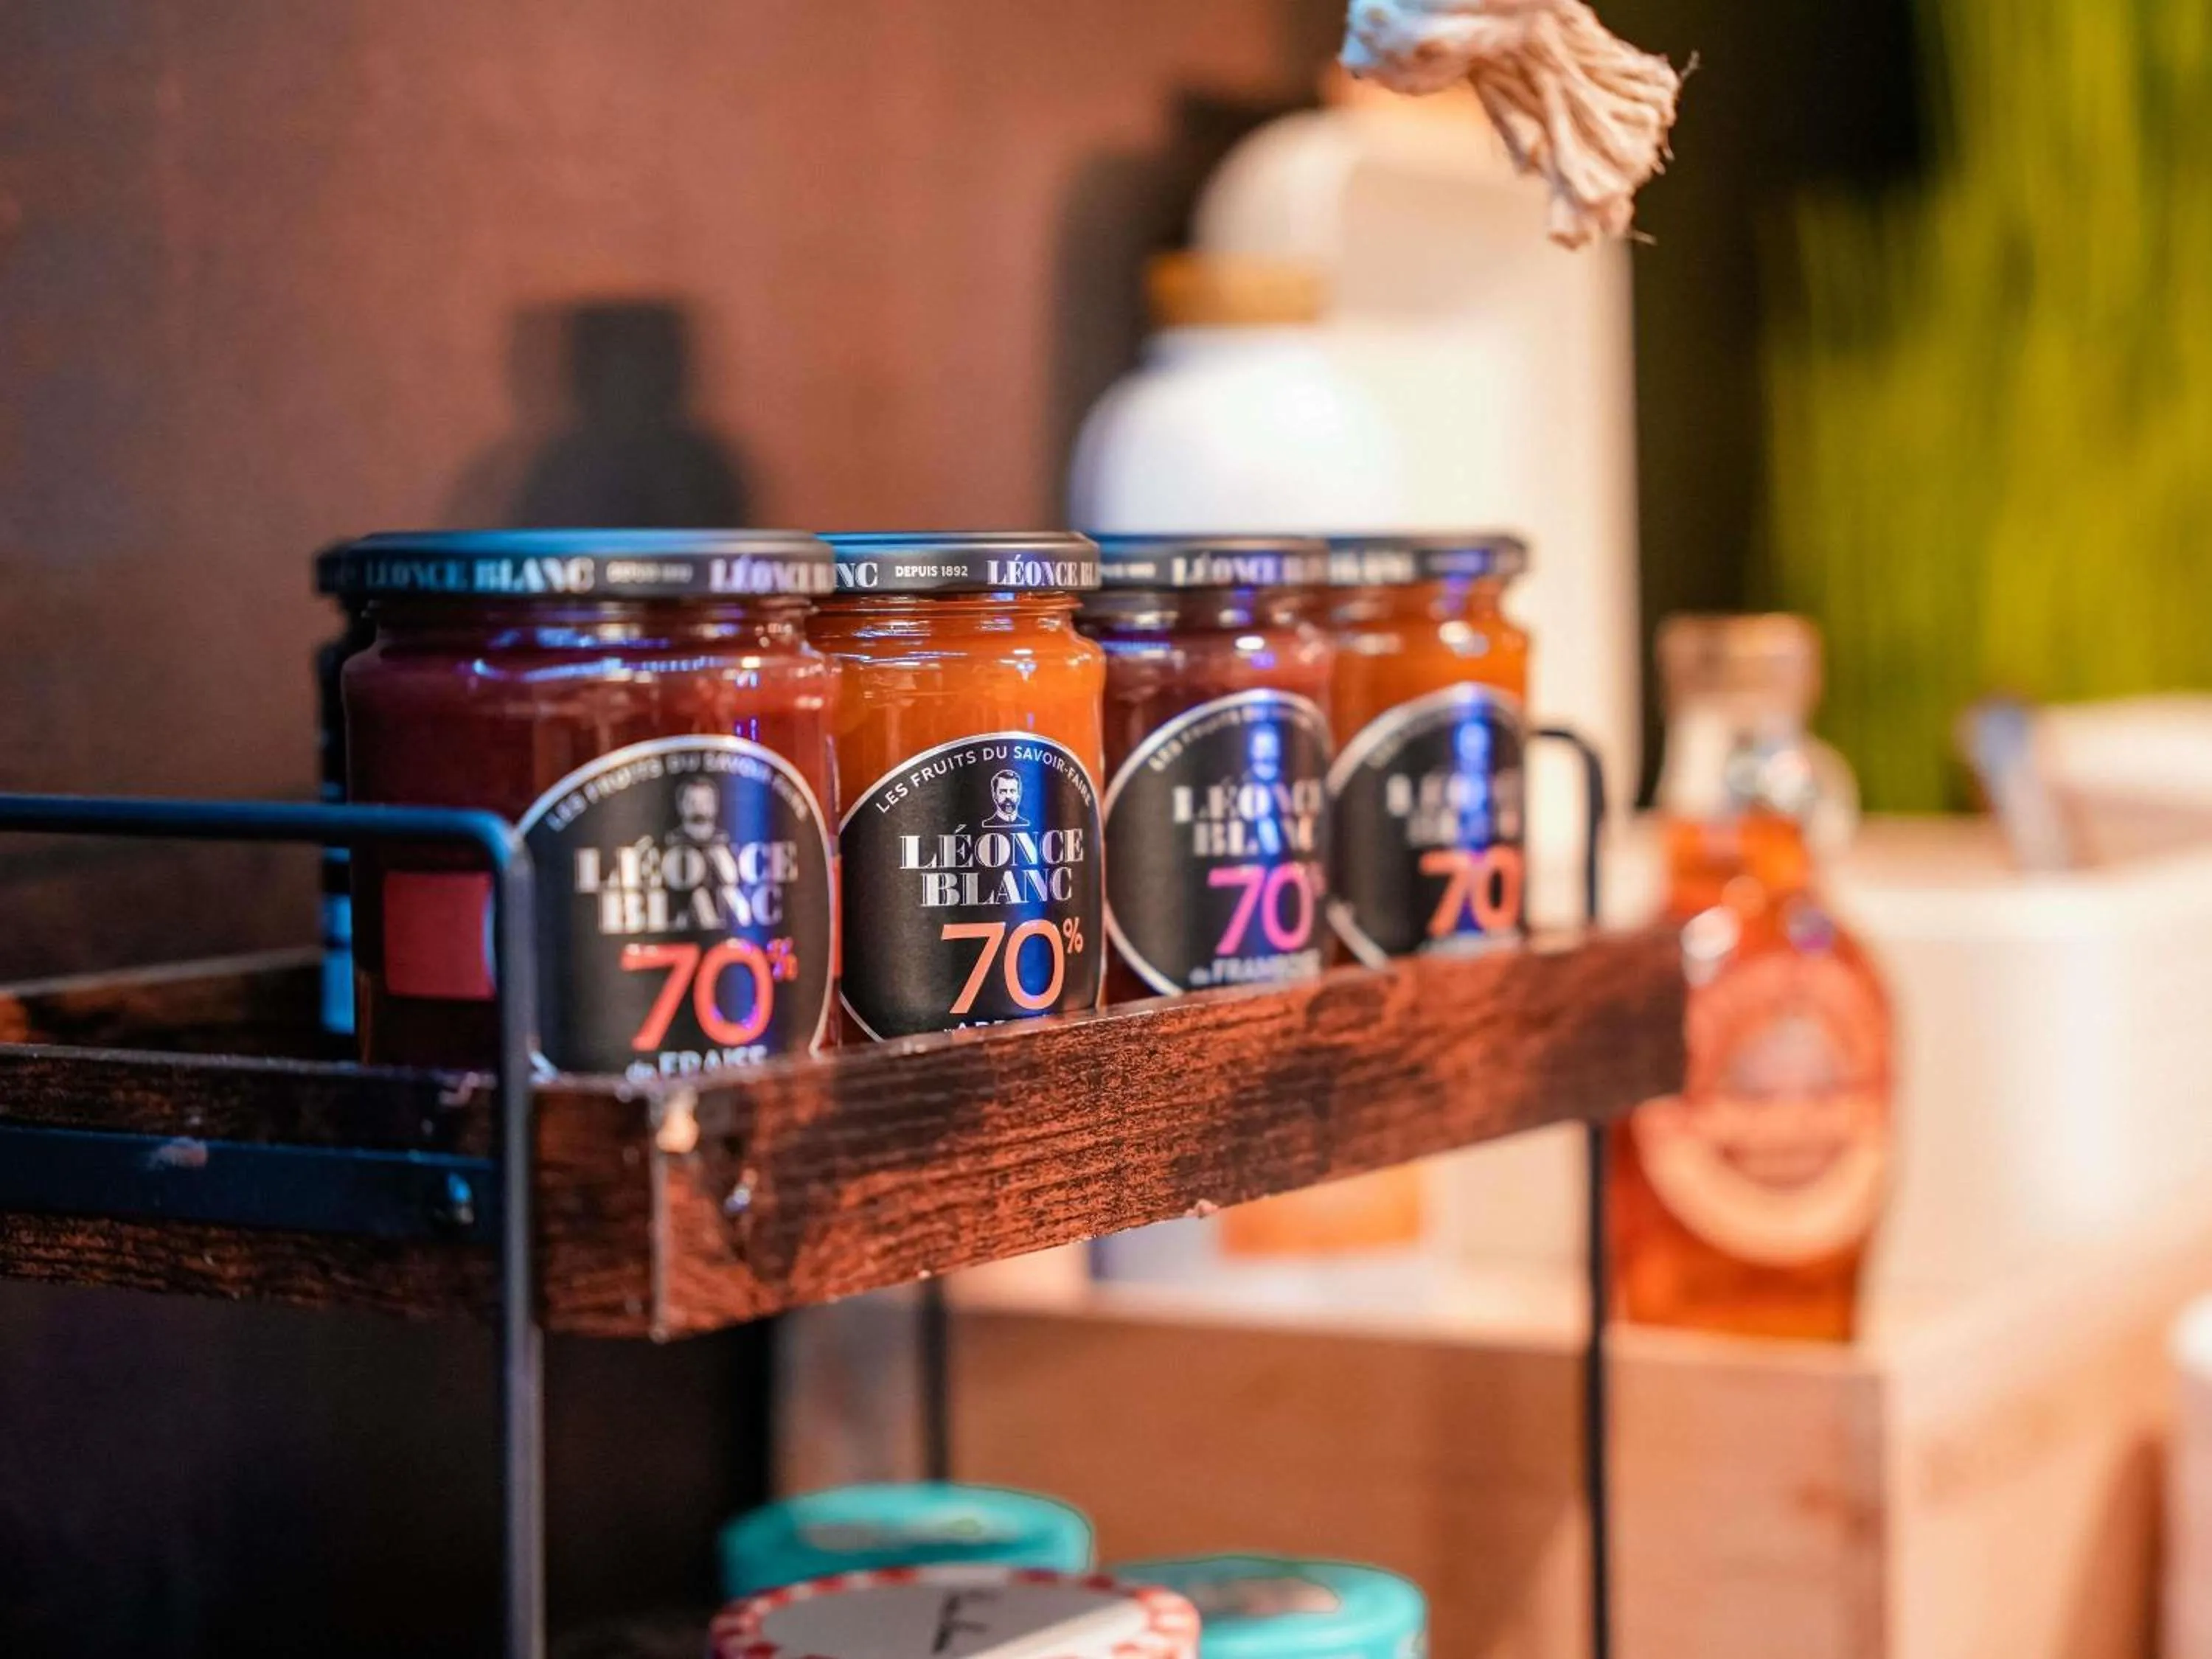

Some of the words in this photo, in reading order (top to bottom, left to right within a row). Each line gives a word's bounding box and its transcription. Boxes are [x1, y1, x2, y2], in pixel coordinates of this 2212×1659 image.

[473, 557, 594, 593] BLANC
[895, 566, 937, 577] DEPUIS
[940, 566, 968, 577] 1892
[987, 554, 1078, 587] LÉONCE
[875, 782, 908, 814] LES
[910, 750, 978, 788] FRUITS
[982, 745, 1008, 762] DU
[1013, 745, 1092, 808] SAVOIR-FAIRE
[574, 835, 798, 893] LÉONCE
[898, 824, 1084, 870] LÉONCE
[599, 886, 784, 934] BLANC
[920, 866, 1073, 908] BLANC
[941, 917, 1084, 1015] 70%
